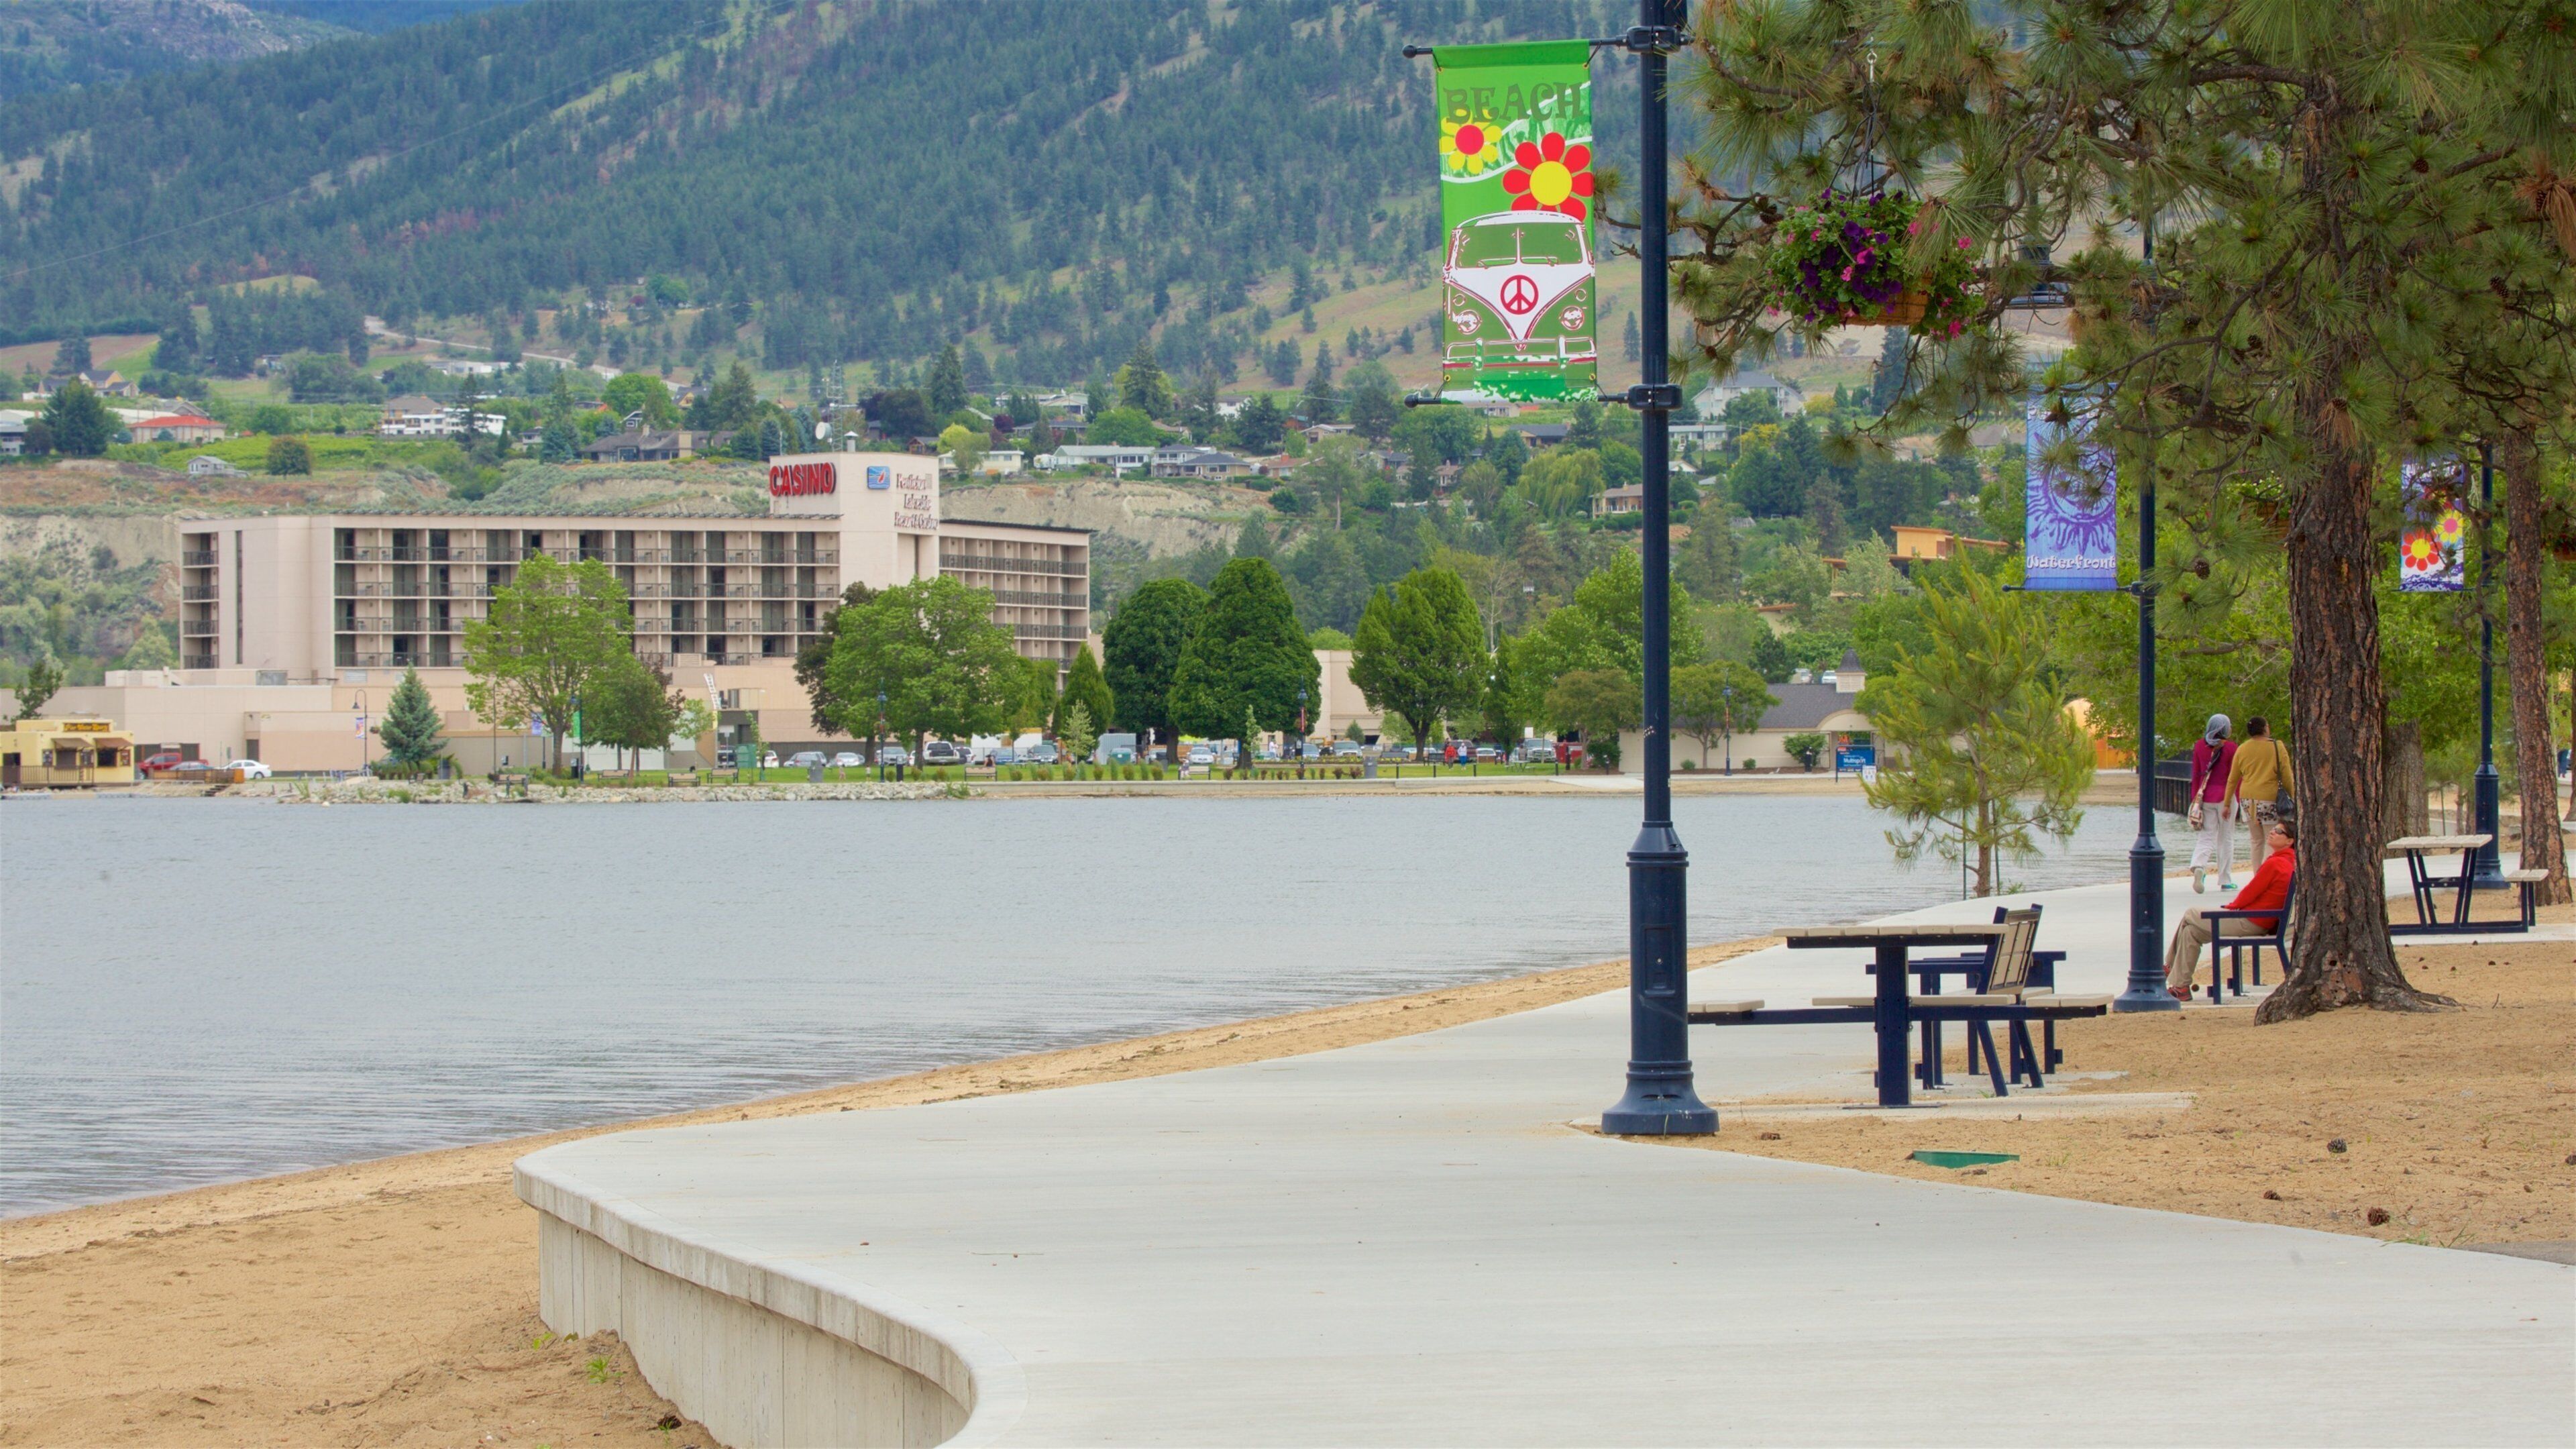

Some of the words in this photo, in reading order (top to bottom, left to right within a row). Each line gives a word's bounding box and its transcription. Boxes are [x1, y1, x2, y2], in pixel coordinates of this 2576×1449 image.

[1443, 82, 1584, 125] BEACH
[768, 462, 835, 497] CASINO
[2027, 555, 2116, 570] Waterfront
